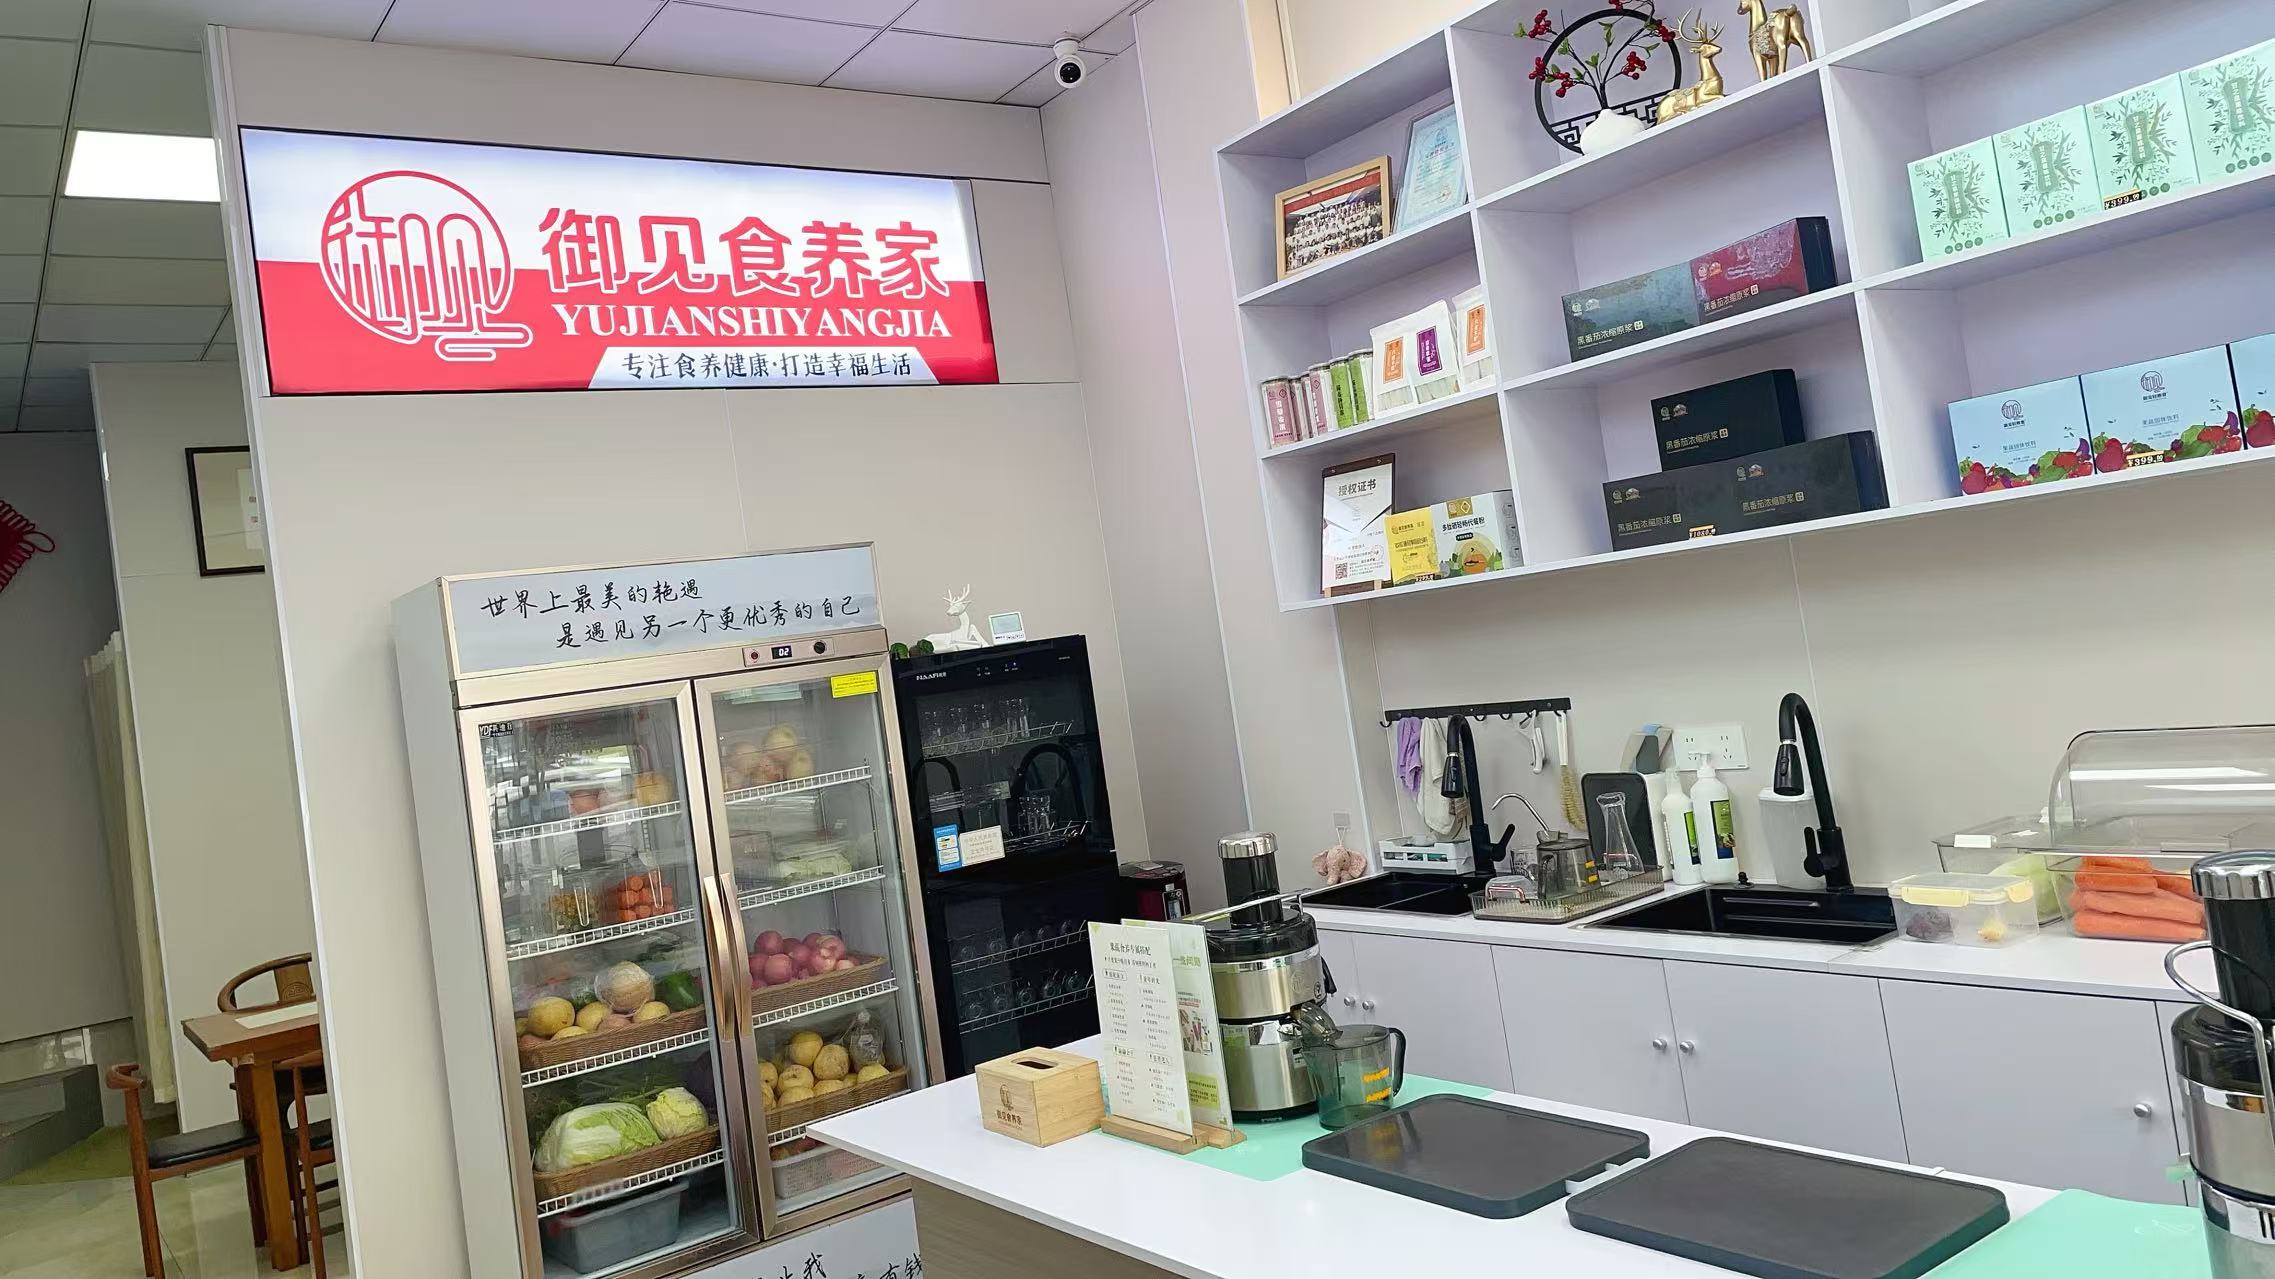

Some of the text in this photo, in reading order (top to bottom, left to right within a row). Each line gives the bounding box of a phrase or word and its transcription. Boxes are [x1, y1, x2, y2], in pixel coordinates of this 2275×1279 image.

[538, 206, 951, 299] 御见食养家
[552, 303, 952, 339] YUJIANSHIYANGJIA
[1577, 321, 1634, 346] 黑番茄浓缩原浆
[620, 350, 912, 381] 专注食养健康·打造幸福生活
[1665, 431, 1719, 451] 黑番茄浓缩原浆
[1338, 478, 1377, 498] 授权证书
[1617, 515, 1673, 533] 黑番茄浓缩原浆
[480, 581, 704, 618] 世界上最美的艳遇
[556, 595, 862, 650] 是遇见另一个更优秀的自己
[778, 646, 789, 658] 02
